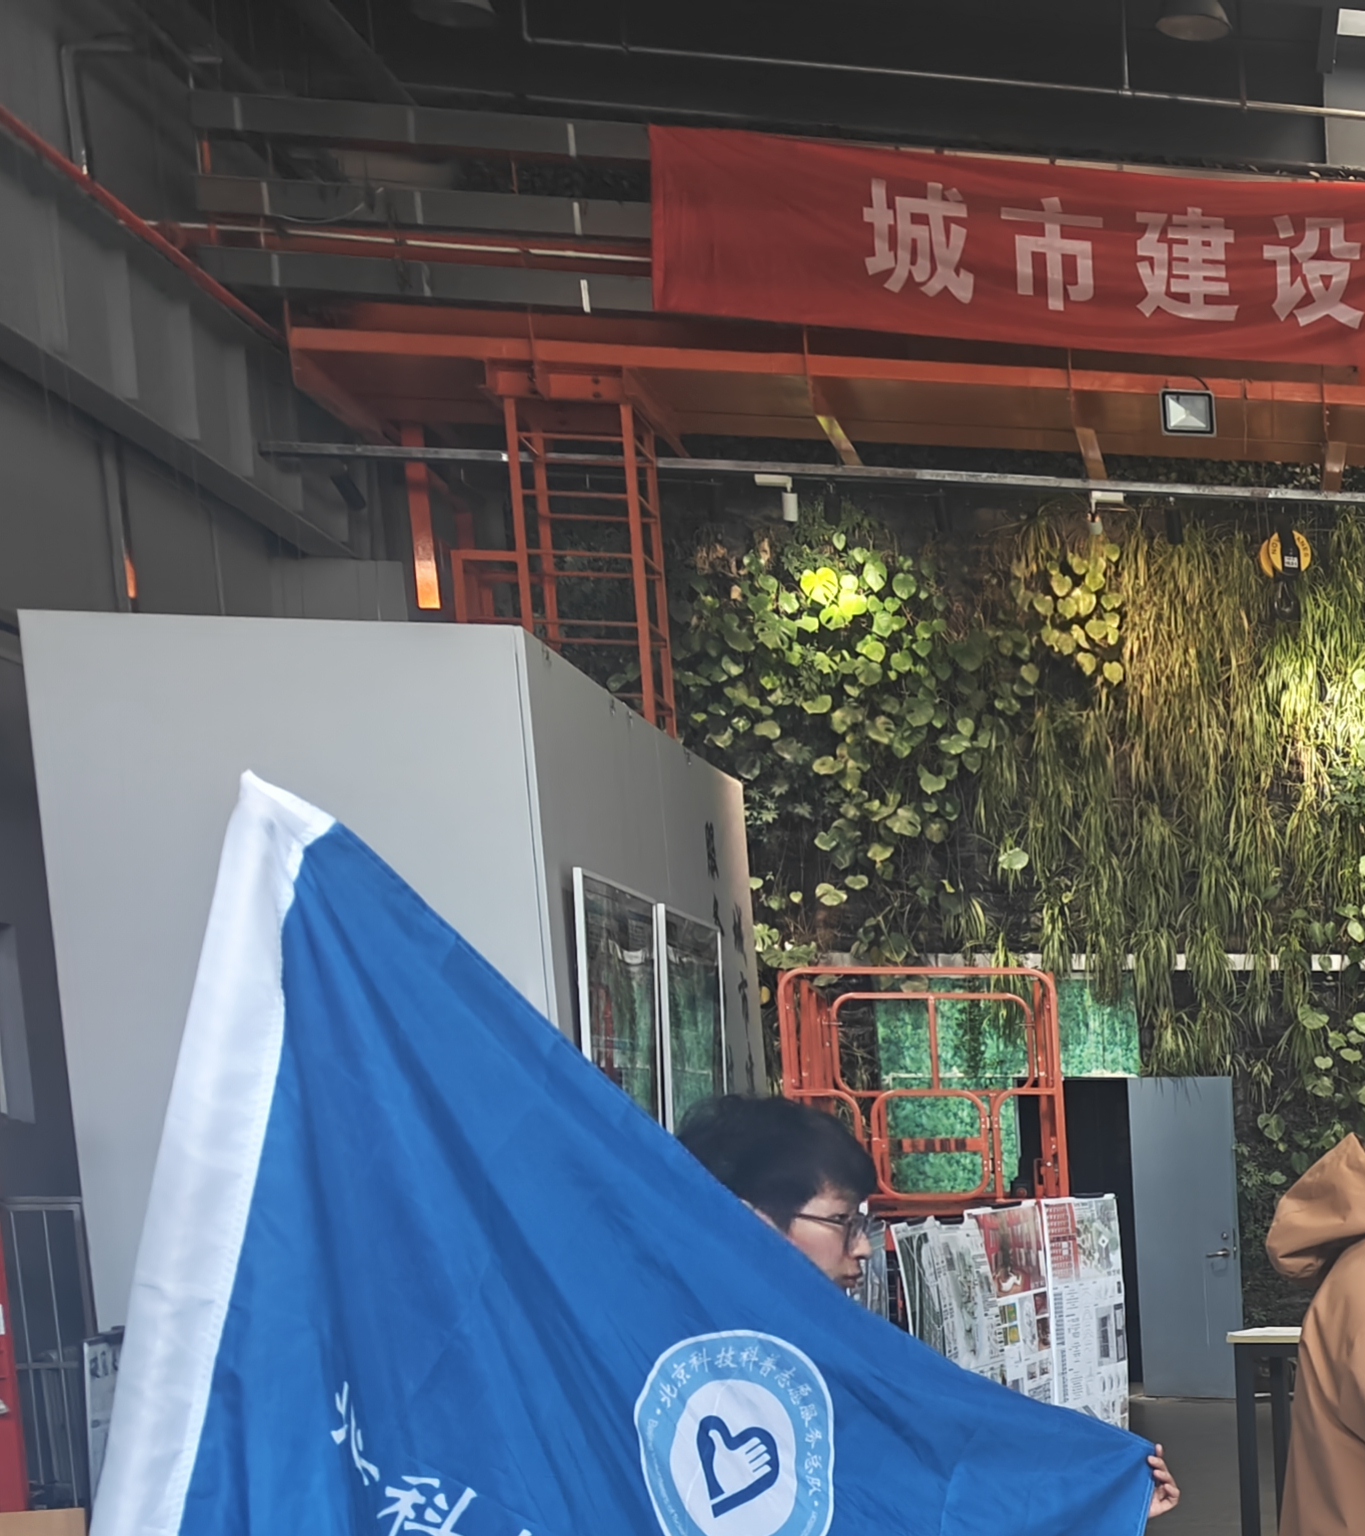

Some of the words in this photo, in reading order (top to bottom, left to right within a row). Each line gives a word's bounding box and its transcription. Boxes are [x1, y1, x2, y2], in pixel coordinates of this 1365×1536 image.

[659, 1346, 822, 1497] 北京科技科普志愿服务总队
